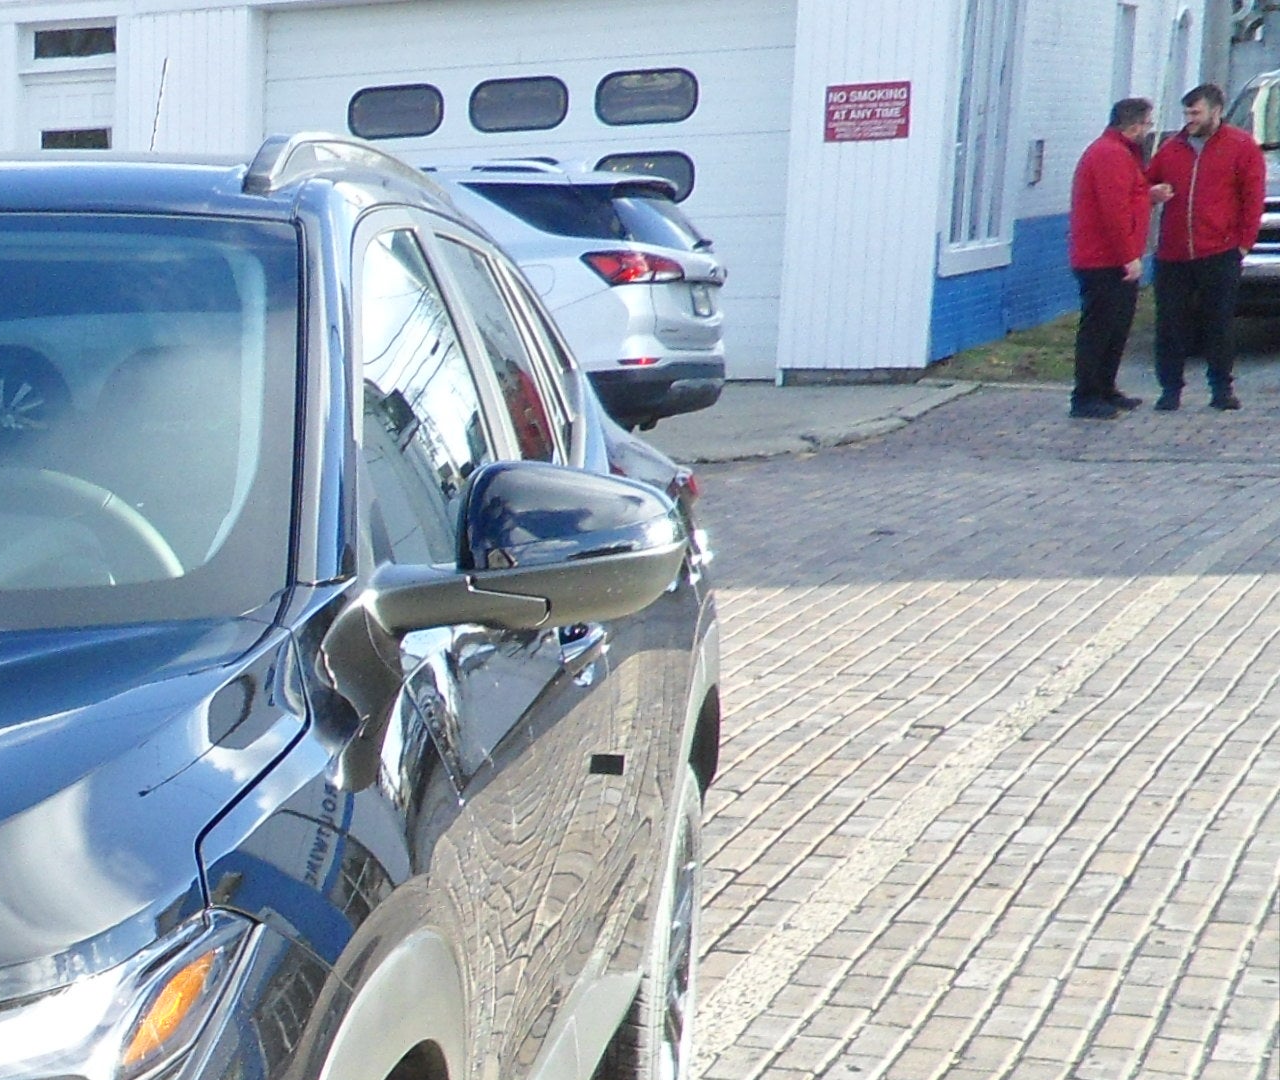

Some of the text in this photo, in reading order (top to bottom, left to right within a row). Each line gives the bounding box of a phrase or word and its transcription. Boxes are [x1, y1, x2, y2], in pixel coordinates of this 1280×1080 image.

[828, 88, 907, 103] NO SMOKING
[833, 106, 902, 120] AT ANY TIME
